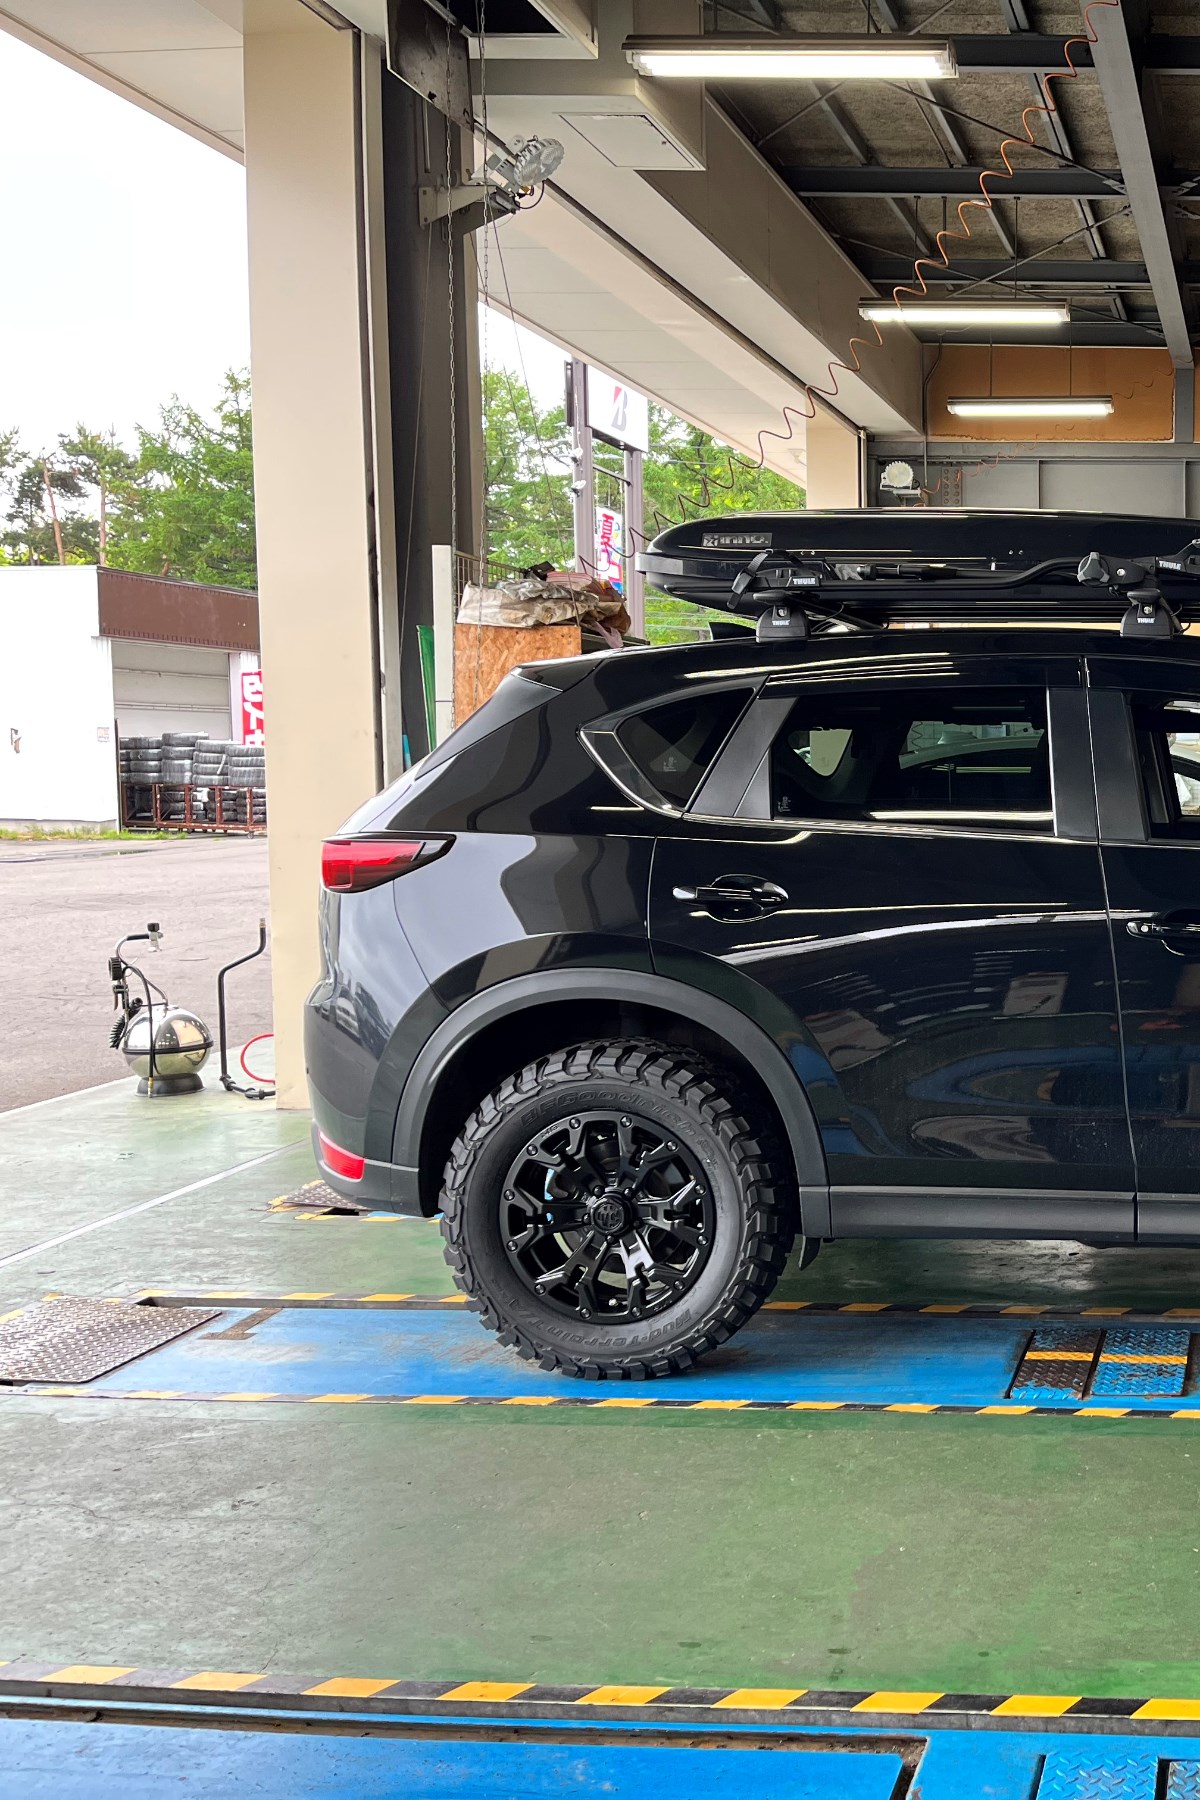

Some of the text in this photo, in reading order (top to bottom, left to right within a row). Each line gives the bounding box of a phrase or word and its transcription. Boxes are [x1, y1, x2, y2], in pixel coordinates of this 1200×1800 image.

[1158, 560, 1182, 571] THULE
[792, 577, 816, 585] THULE
[521, 1090, 696, 1137] BFGoodrich
